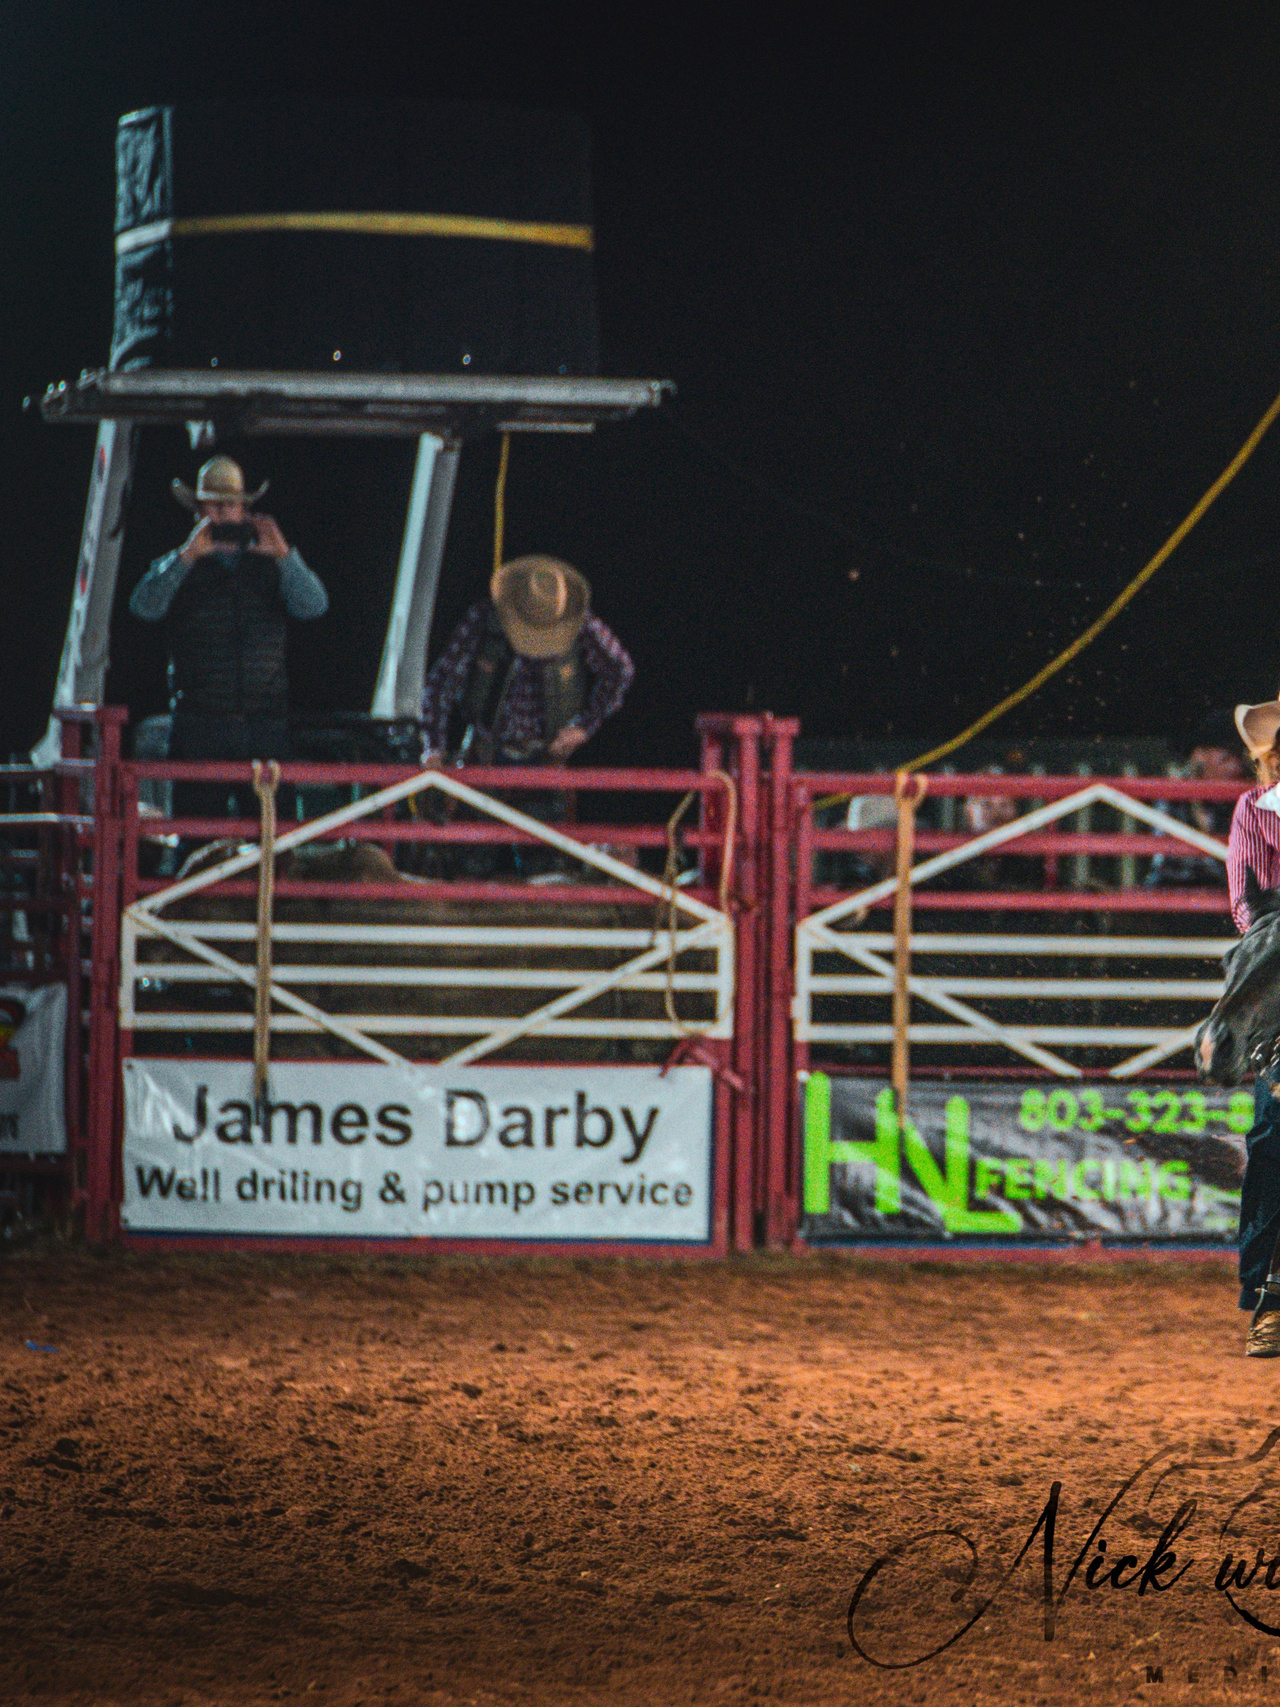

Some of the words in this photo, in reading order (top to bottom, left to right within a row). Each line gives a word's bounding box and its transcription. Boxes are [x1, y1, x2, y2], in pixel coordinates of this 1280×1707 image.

[173, 1086, 414, 1146] James
[444, 1090, 660, 1162] Darby
[136, 1165, 221, 1203] Well
[236, 1169, 363, 1211] driling
[379, 1175, 407, 1206] &
[423, 1178, 537, 1212] pump
[550, 1174, 694, 1207] service
[976, 1157, 1192, 1200] FENCING
